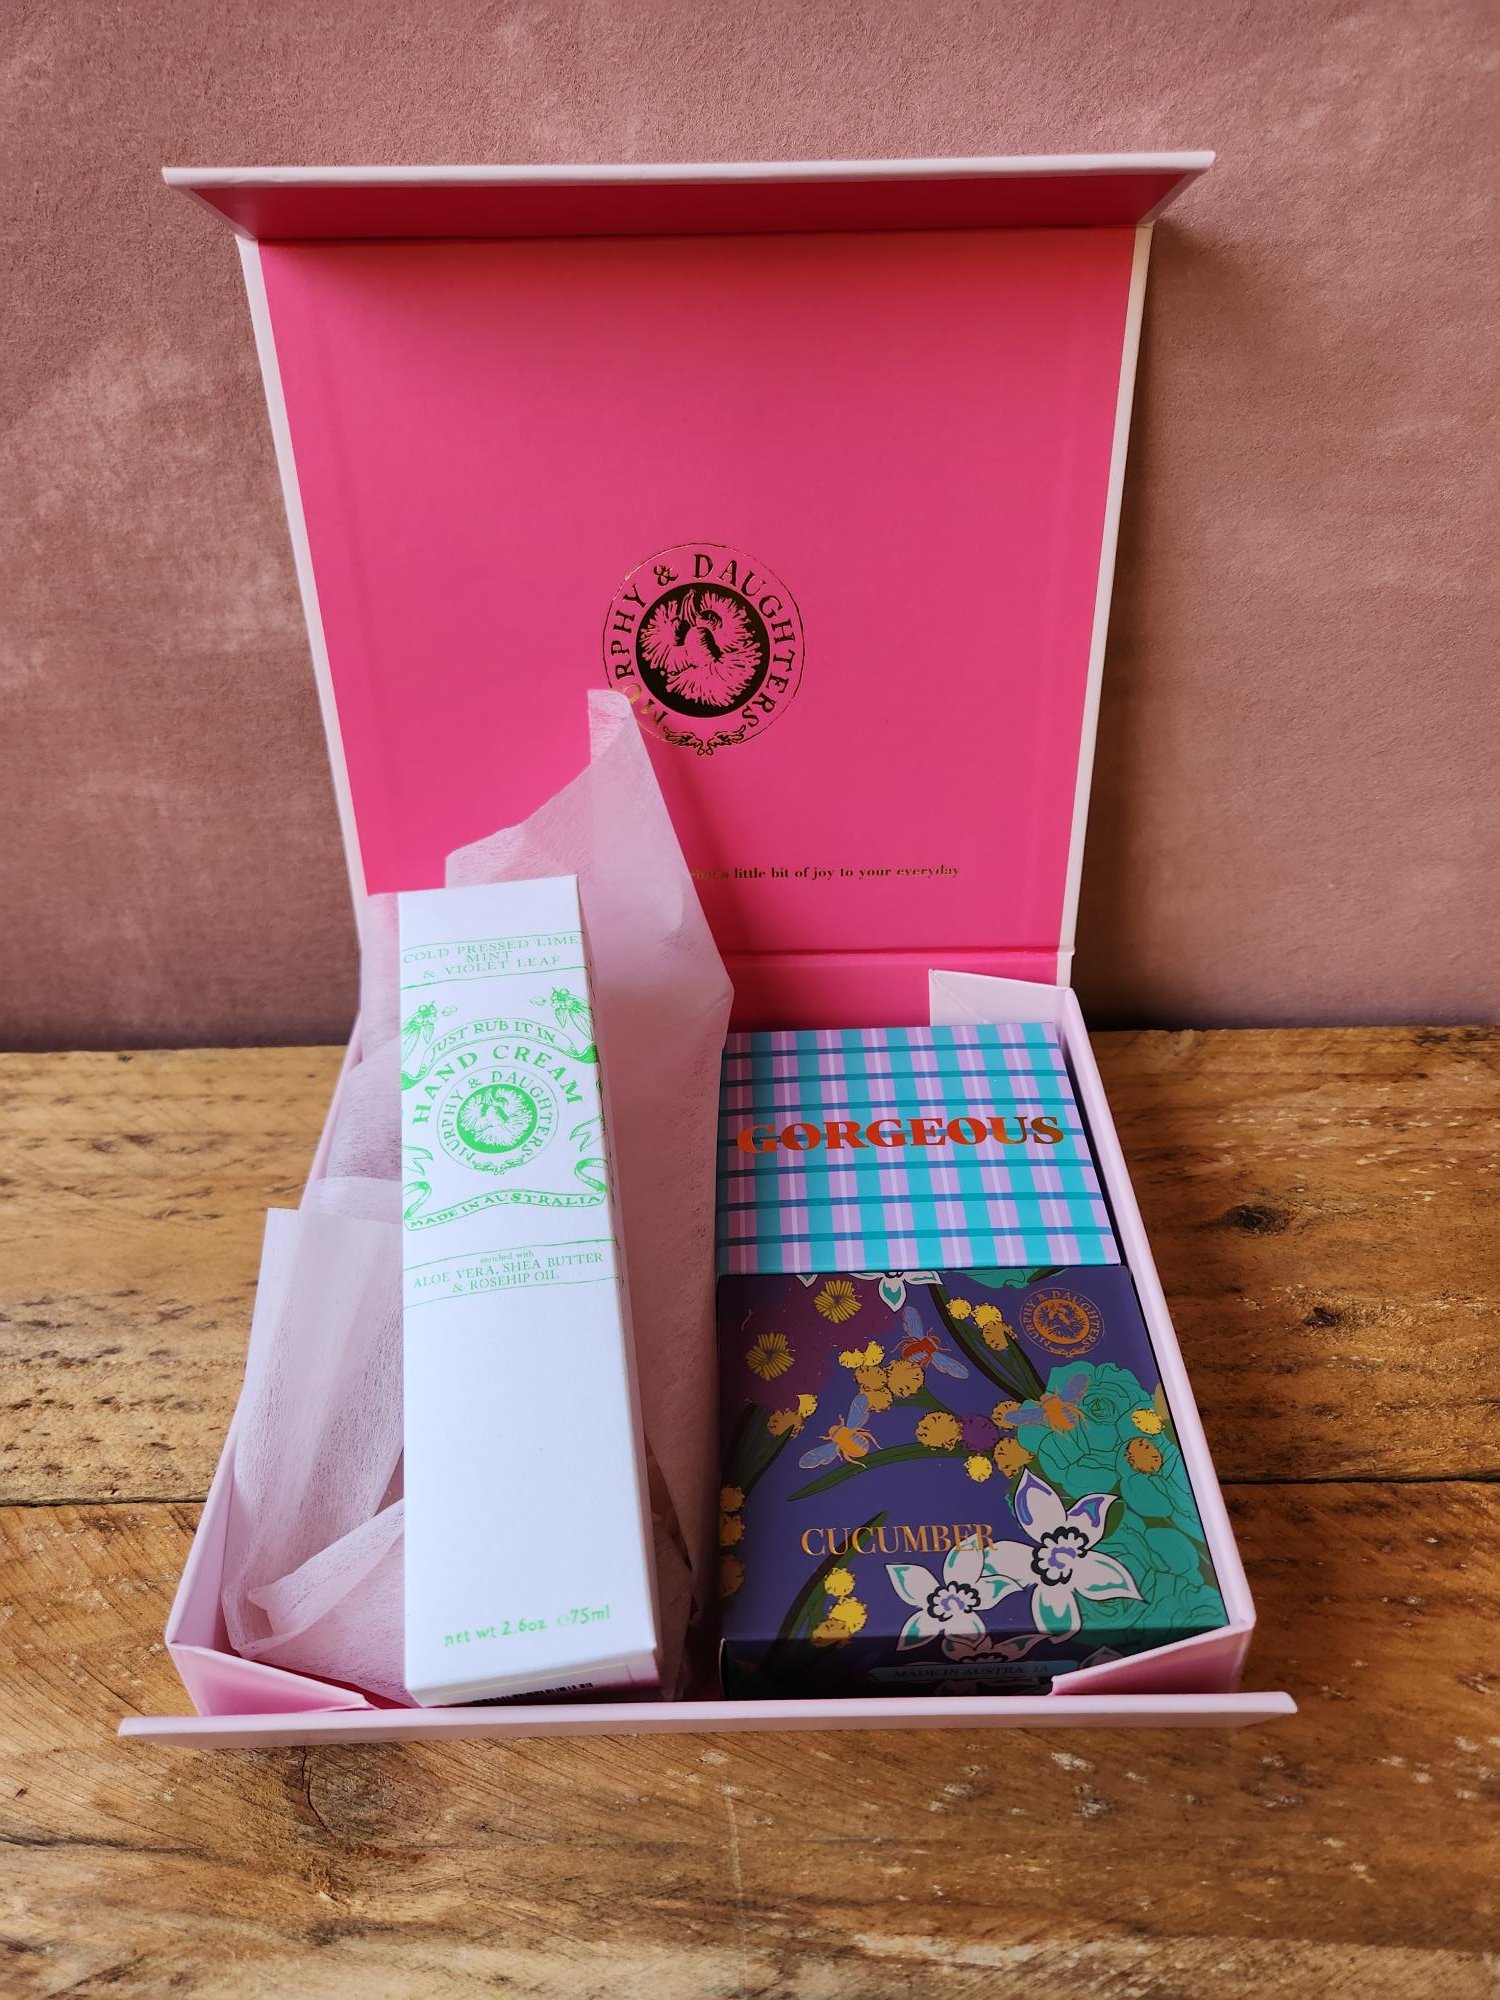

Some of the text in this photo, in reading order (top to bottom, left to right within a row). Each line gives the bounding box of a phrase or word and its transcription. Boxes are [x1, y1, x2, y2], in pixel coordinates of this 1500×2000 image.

[653, 564, 678, 587] &
[693, 553, 796, 728] DAUGHTERS
[734, 866, 766, 879] little
[771, 866, 788, 879] bit
[795, 866, 810, 878] of
[812, 867, 833, 880] joy
[840, 868, 853, 878] to
[859, 868, 891, 880] your
[896, 864, 960, 880] everyday
[403, 947, 449, 964] COLD
[457, 939, 529, 955] PRESSED
[423, 955, 561, 980] & VIOLET LEAF
[467, 950, 512, 963] MINT
[432, 1020, 555, 1059] JUST RUB IT IN
[412, 1044, 584, 1125] HAND CREAM
[441, 1070, 554, 1161] MURPHY & DAUGHTERS
[736, 1115, 1065, 1155] GORGEOUS
[410, 1192, 601, 1228] MADE IN AUSTRALIA
[413, 1252, 605, 1289] ALOE VERA, SHEA BUTTER
[480, 1250, 534, 1264] enriched with
[452, 1269, 560, 1293] & ROSEHIP OIL
[800, 1522, 998, 1557] CUCUMBER
[444, 1630, 471, 1647] net
[476, 1626, 496, 1640] wt
[501, 1618, 547, 1636] 2.6oz
[894, 1665, 1049, 1678] MADE IN AUSTRAIA
